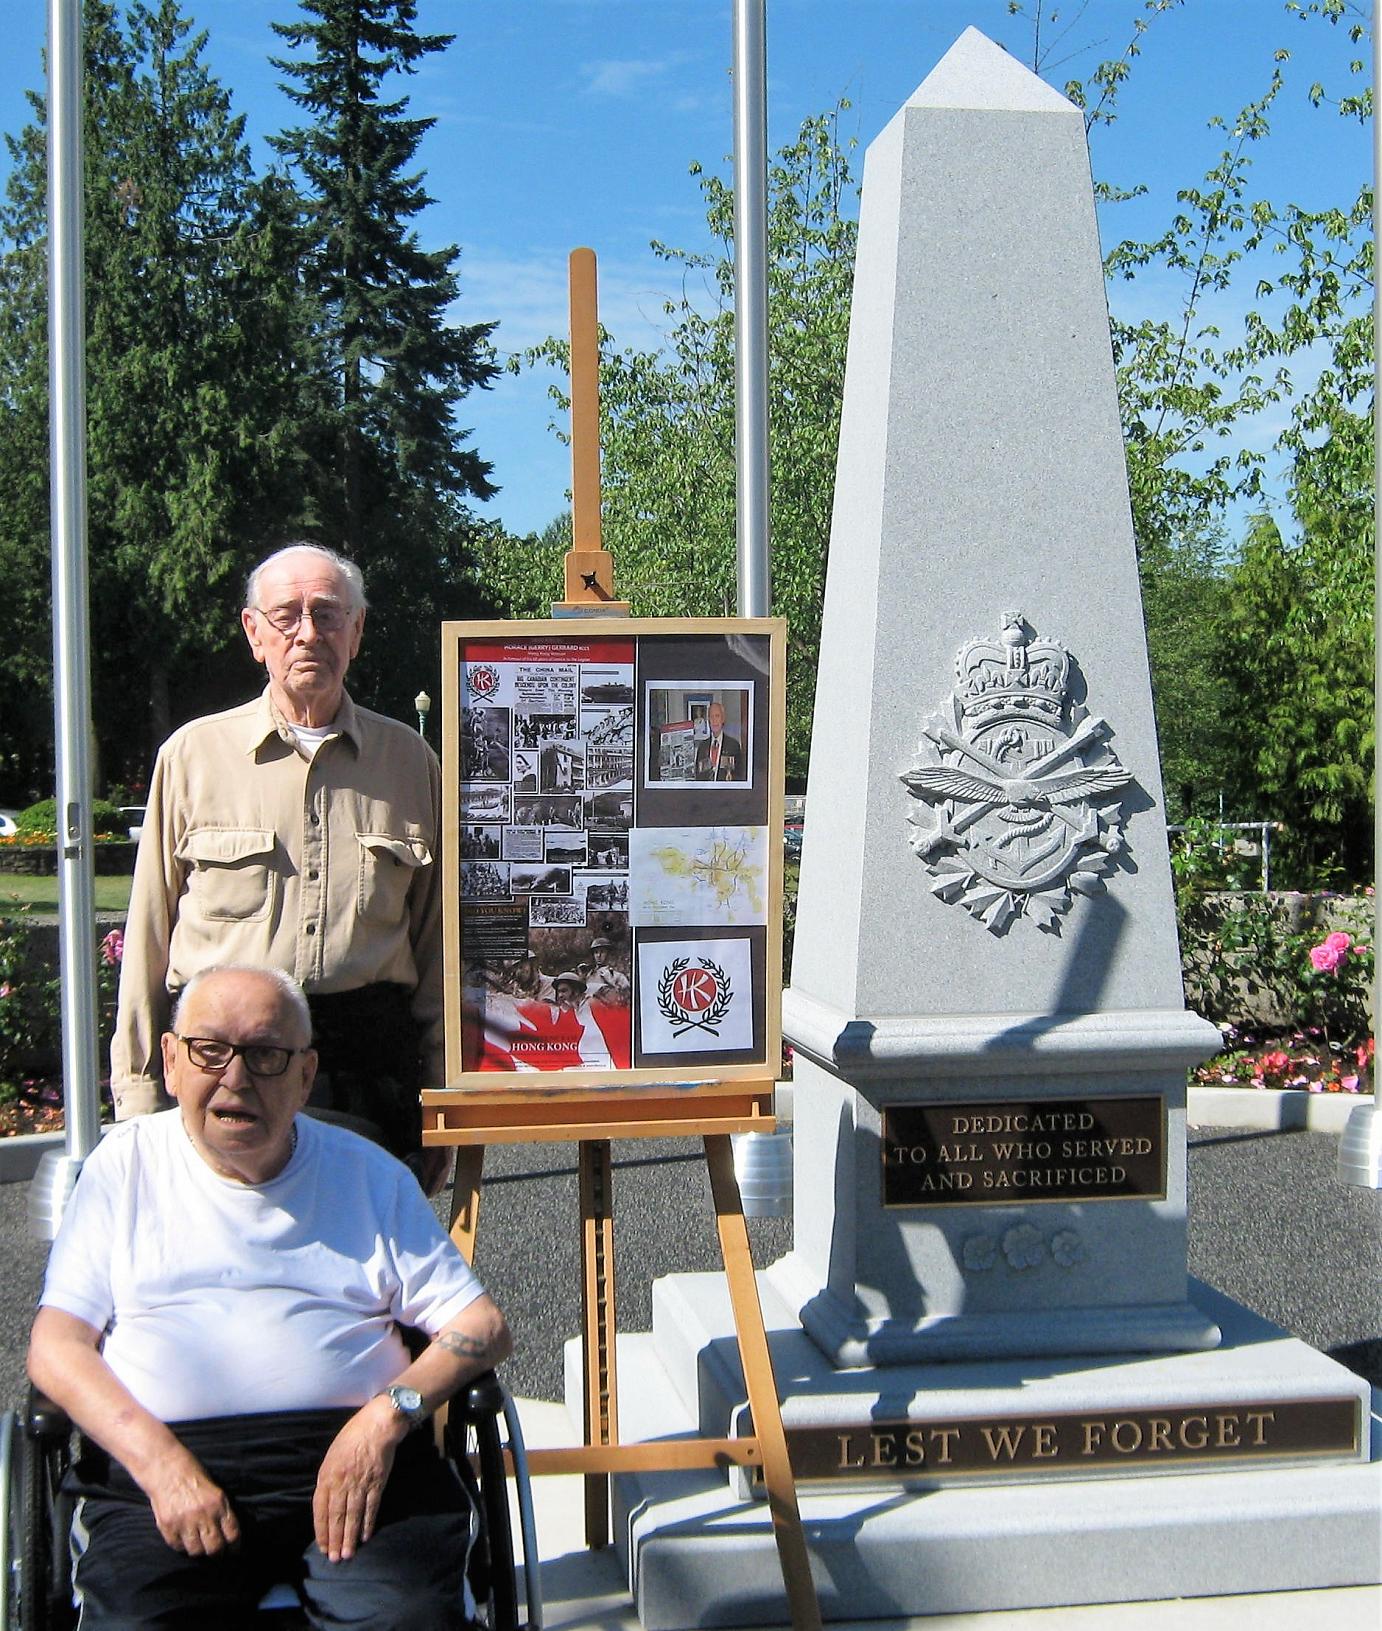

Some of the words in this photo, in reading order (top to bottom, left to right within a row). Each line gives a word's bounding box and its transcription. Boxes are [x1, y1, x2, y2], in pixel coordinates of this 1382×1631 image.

[512, 1042, 545, 1051] HONG
[546, 1042, 578, 1051] KONG
[952, 1113, 1095, 1134] DEDICATED
[893, 1146, 927, 1164] TO
[938, 1144, 984, 1162] ALL
[992, 1142, 1052, 1160] WHO
[1062, 1138, 1152, 1158] SERVED
[921, 1172, 973, 1191] AND
[983, 1166, 1126, 1188] SACRIFICED
[838, 1428, 961, 1467] LEST
[981, 1423, 1059, 1460] WE
[1080, 1411, 1275, 1455] FORGET
